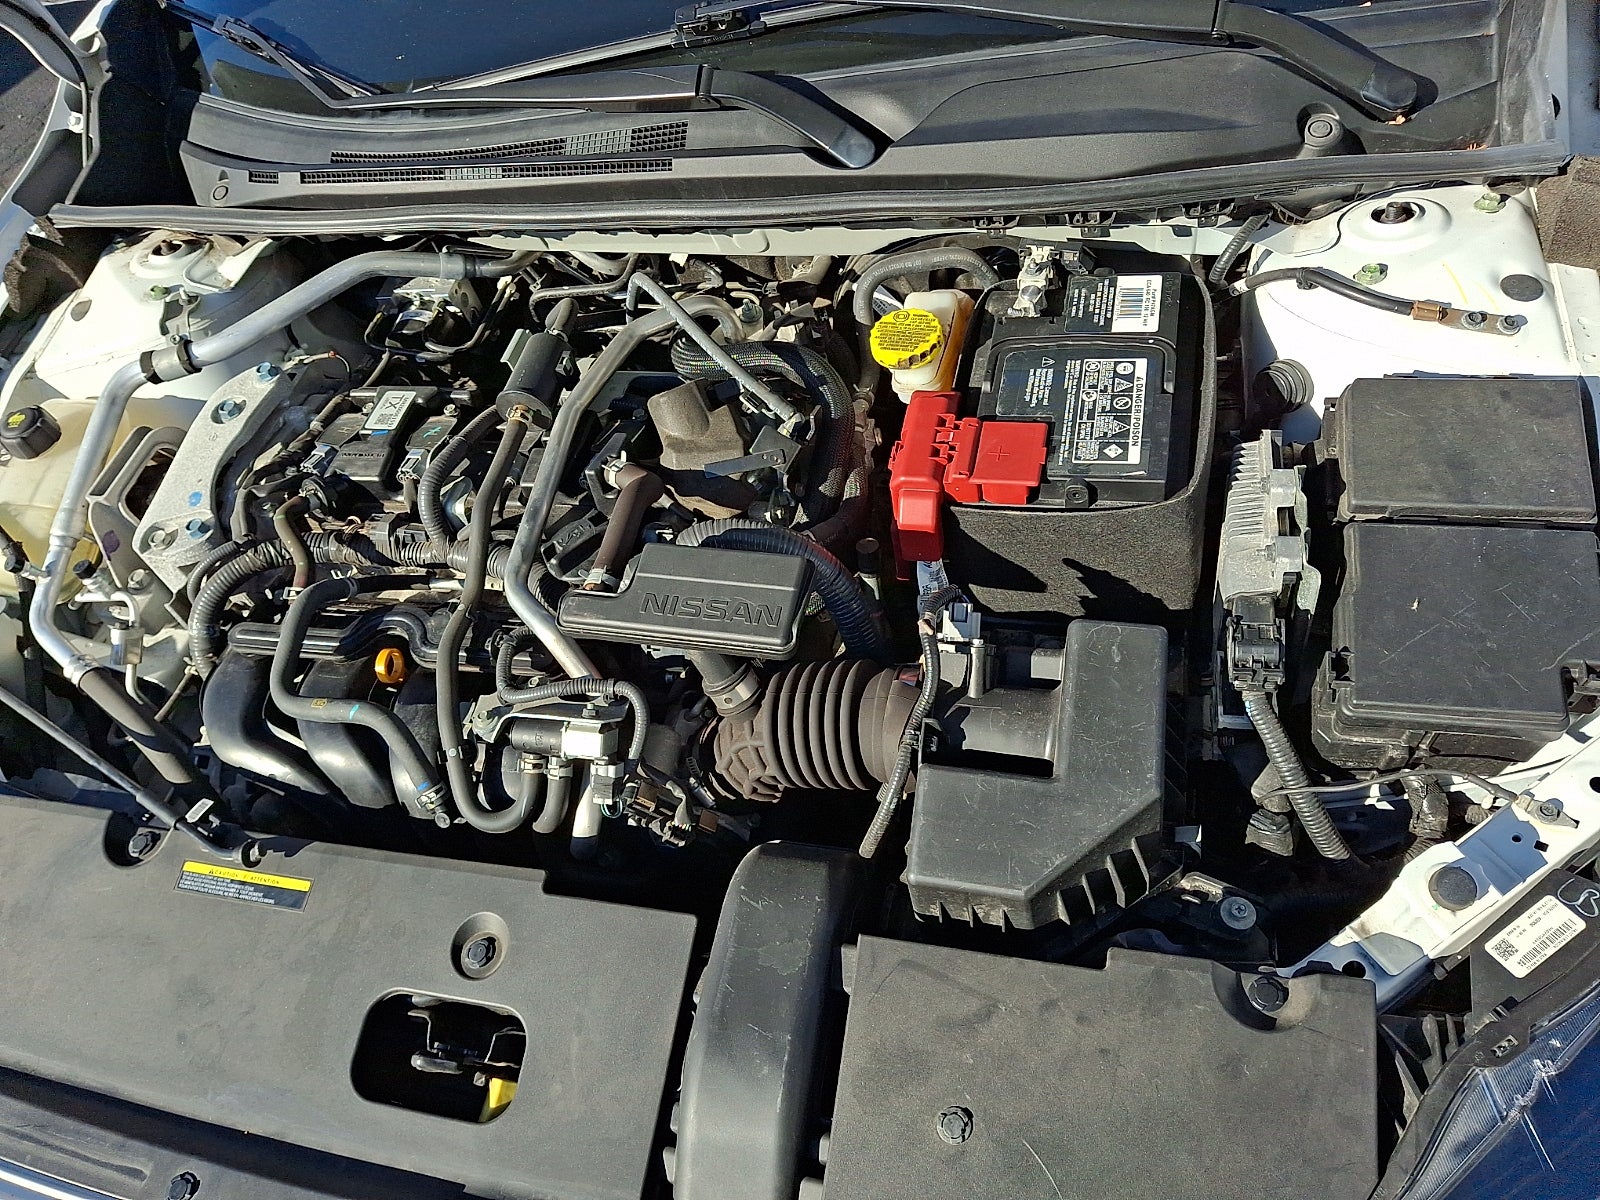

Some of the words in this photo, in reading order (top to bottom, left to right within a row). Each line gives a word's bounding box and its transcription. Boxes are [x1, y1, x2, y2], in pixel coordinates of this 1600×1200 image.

[385, 395, 405, 409] TX
[640, 592, 782, 627] NISSAN
[214, 870, 239, 878] CAUTION
[250, 876, 280, 885] ATTENTION
